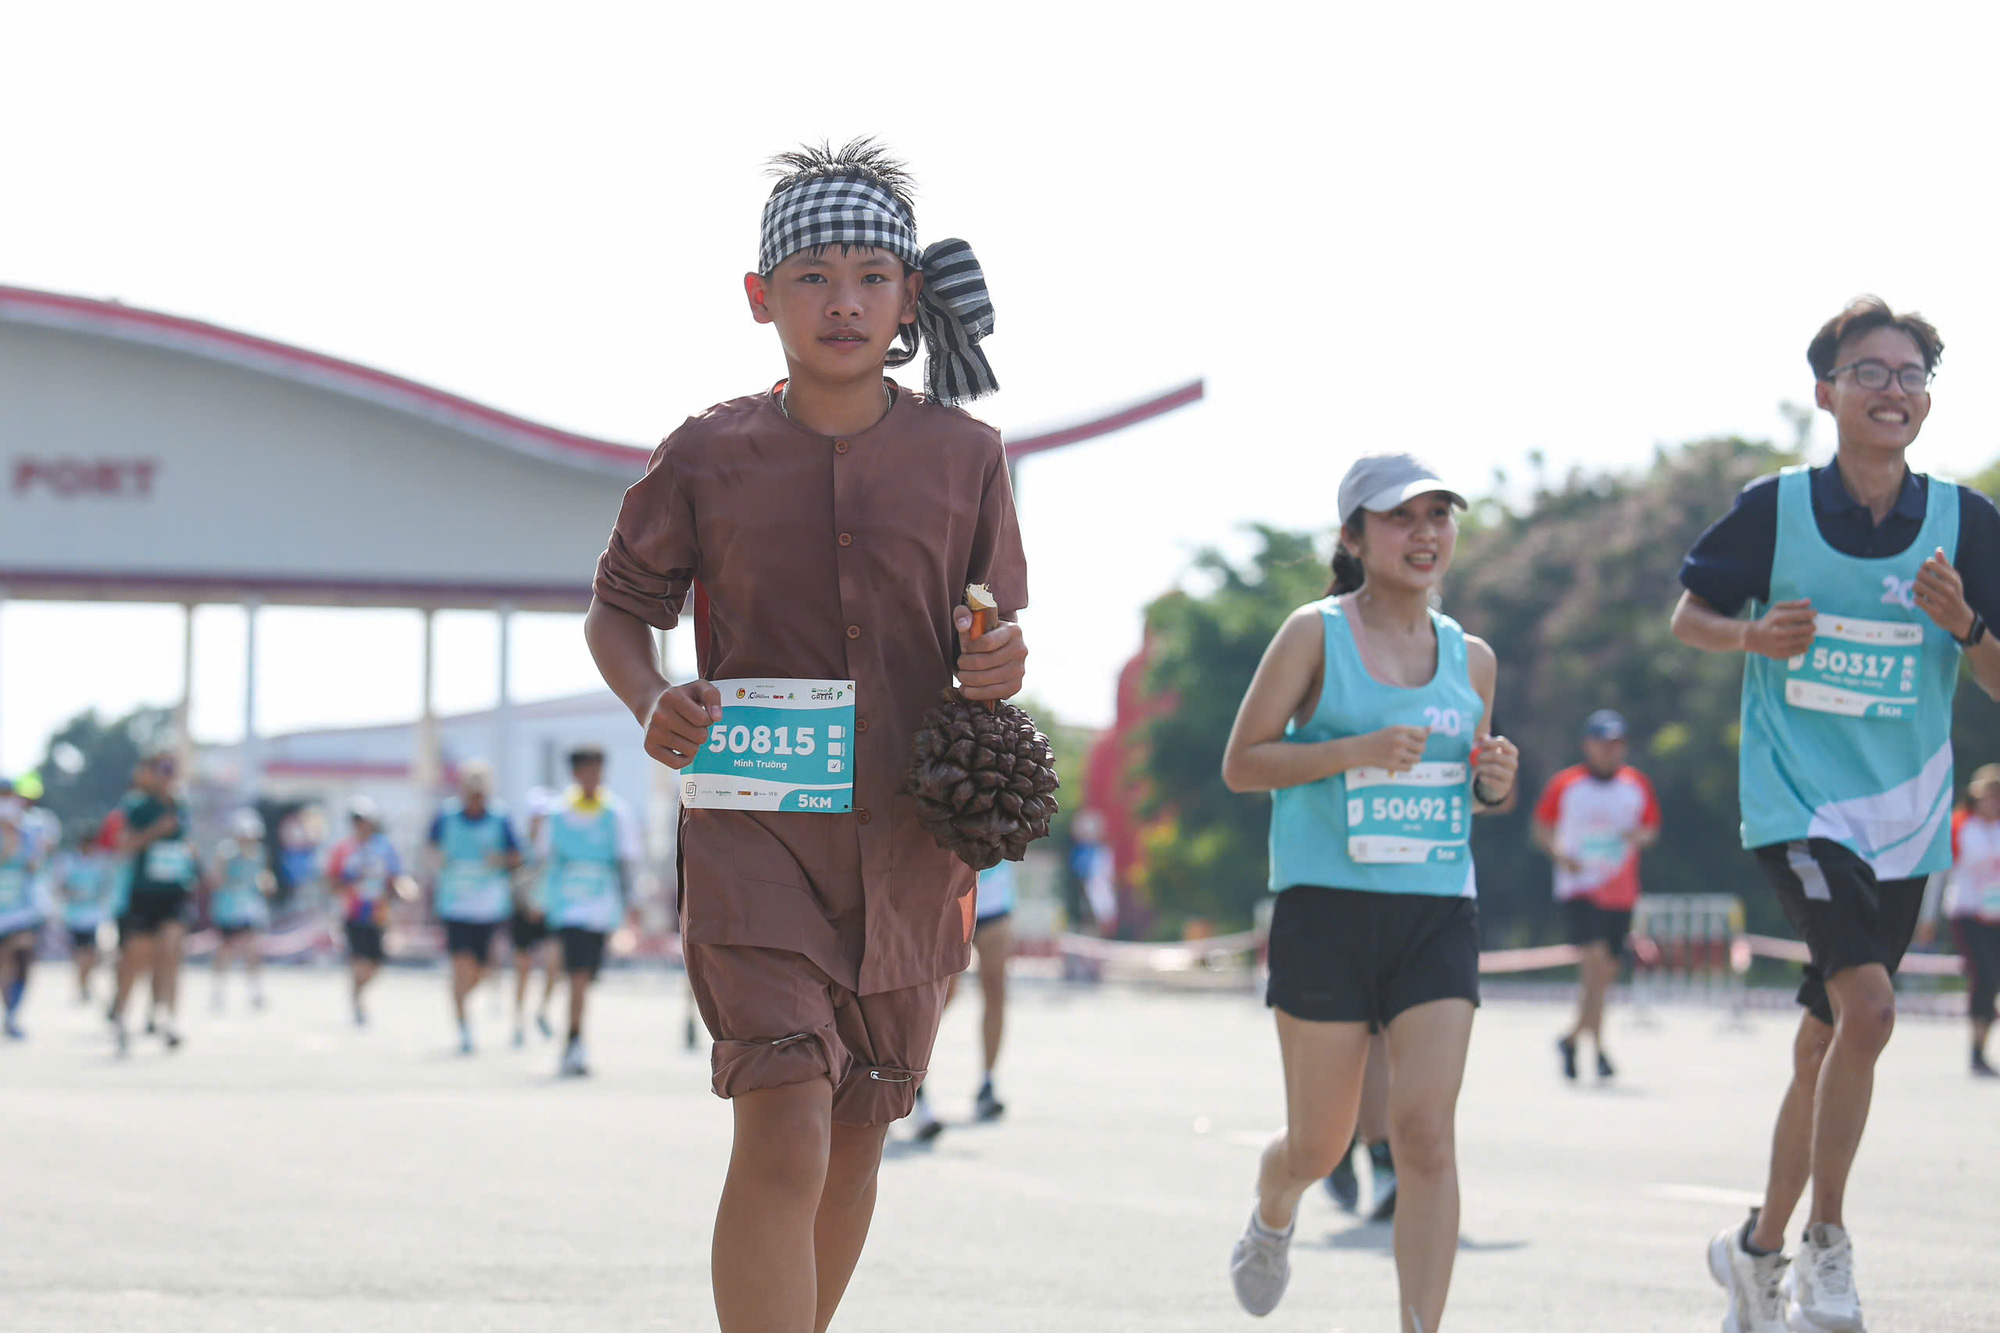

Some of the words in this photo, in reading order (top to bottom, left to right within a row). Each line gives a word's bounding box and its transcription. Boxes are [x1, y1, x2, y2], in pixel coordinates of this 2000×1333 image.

[1812, 647, 1896, 679] 50317
[1424, 706, 1460, 737] 20
[708, 725, 816, 756] 50815
[733, 758, 754, 768] Minh
[797, 794, 832, 809] 5KM
[1372, 797, 1447, 821] 50692
